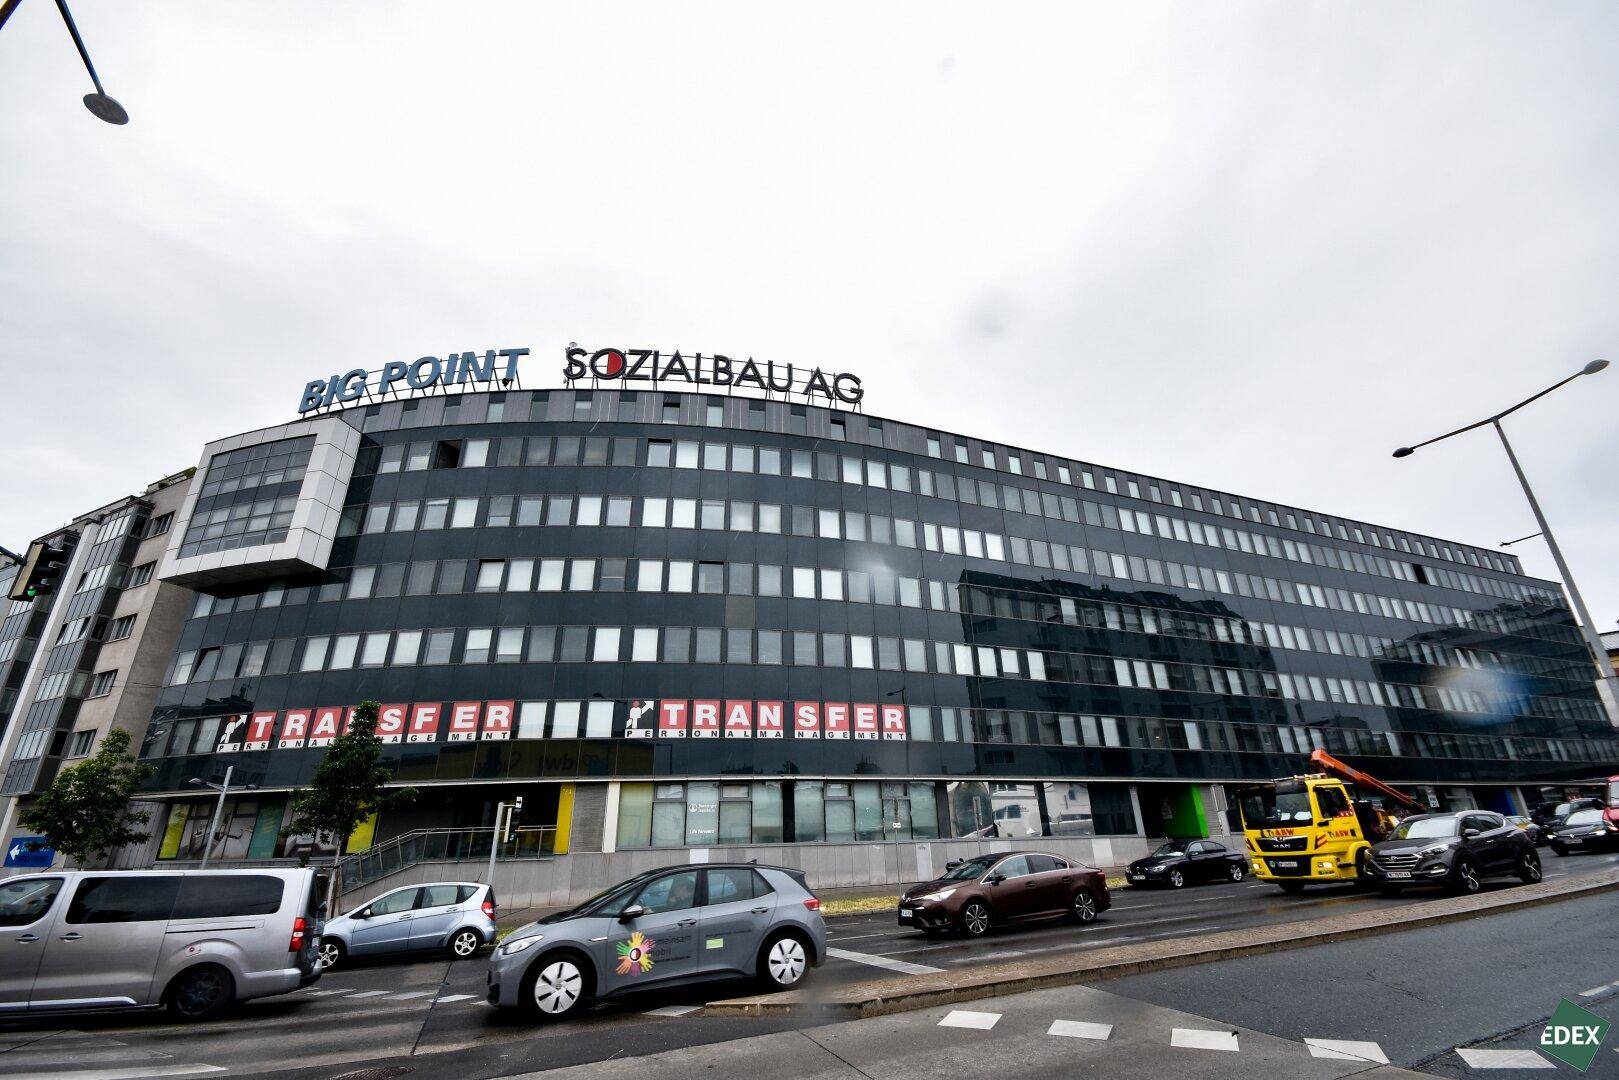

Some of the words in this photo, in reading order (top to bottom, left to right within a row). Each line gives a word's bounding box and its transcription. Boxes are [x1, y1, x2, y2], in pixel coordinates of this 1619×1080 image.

[298, 369, 368, 413] BIG
[379, 348, 530, 393] POINT
[563, 347, 794, 391] SOZIALBAU
[803, 369, 865, 403] AG
[254, 705, 511, 738] TRASFER
[663, 704, 903, 729] TRANSFER
[218, 731, 508, 752] PERSONALAGEMENT
